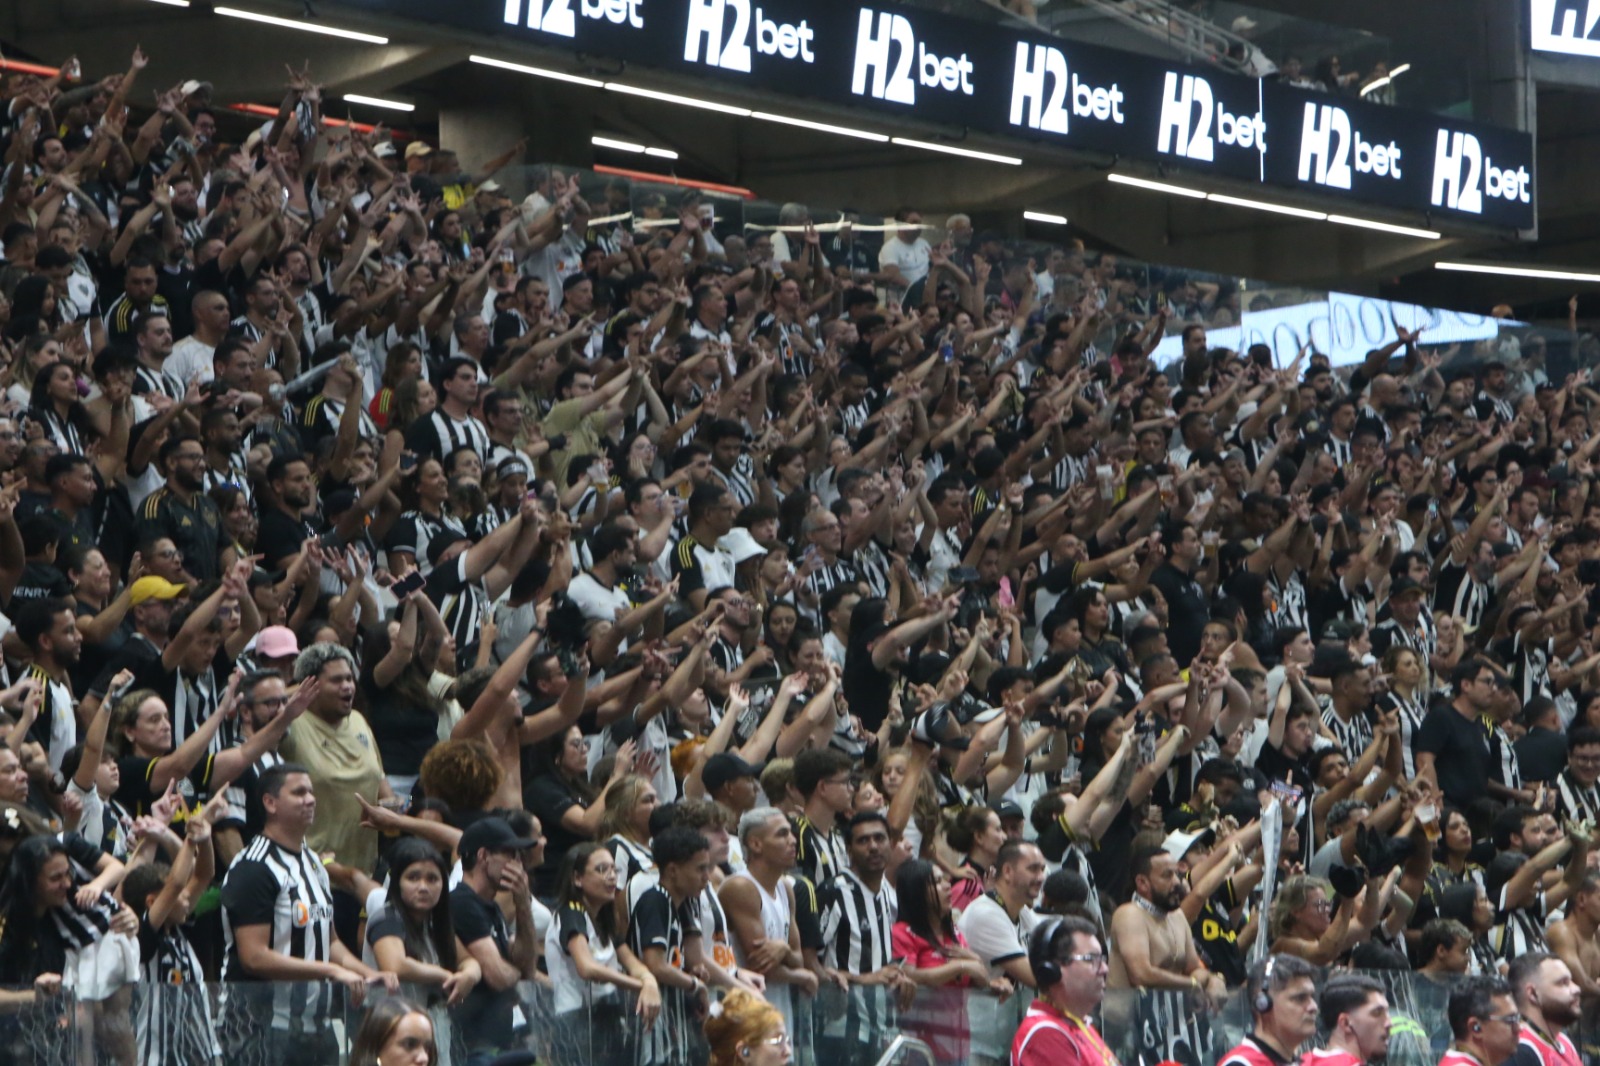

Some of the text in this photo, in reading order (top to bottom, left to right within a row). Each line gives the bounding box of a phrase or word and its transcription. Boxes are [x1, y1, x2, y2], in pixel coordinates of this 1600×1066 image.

[684, 0, 815, 73] H2 bet
[851, 7, 974, 105] H2 bet
[1009, 40, 1125, 135] H2 bet
[1157, 71, 1267, 162] H2 bet
[1298, 101, 1402, 190] H2 bet
[1430, 128, 1531, 214] H2 bet
